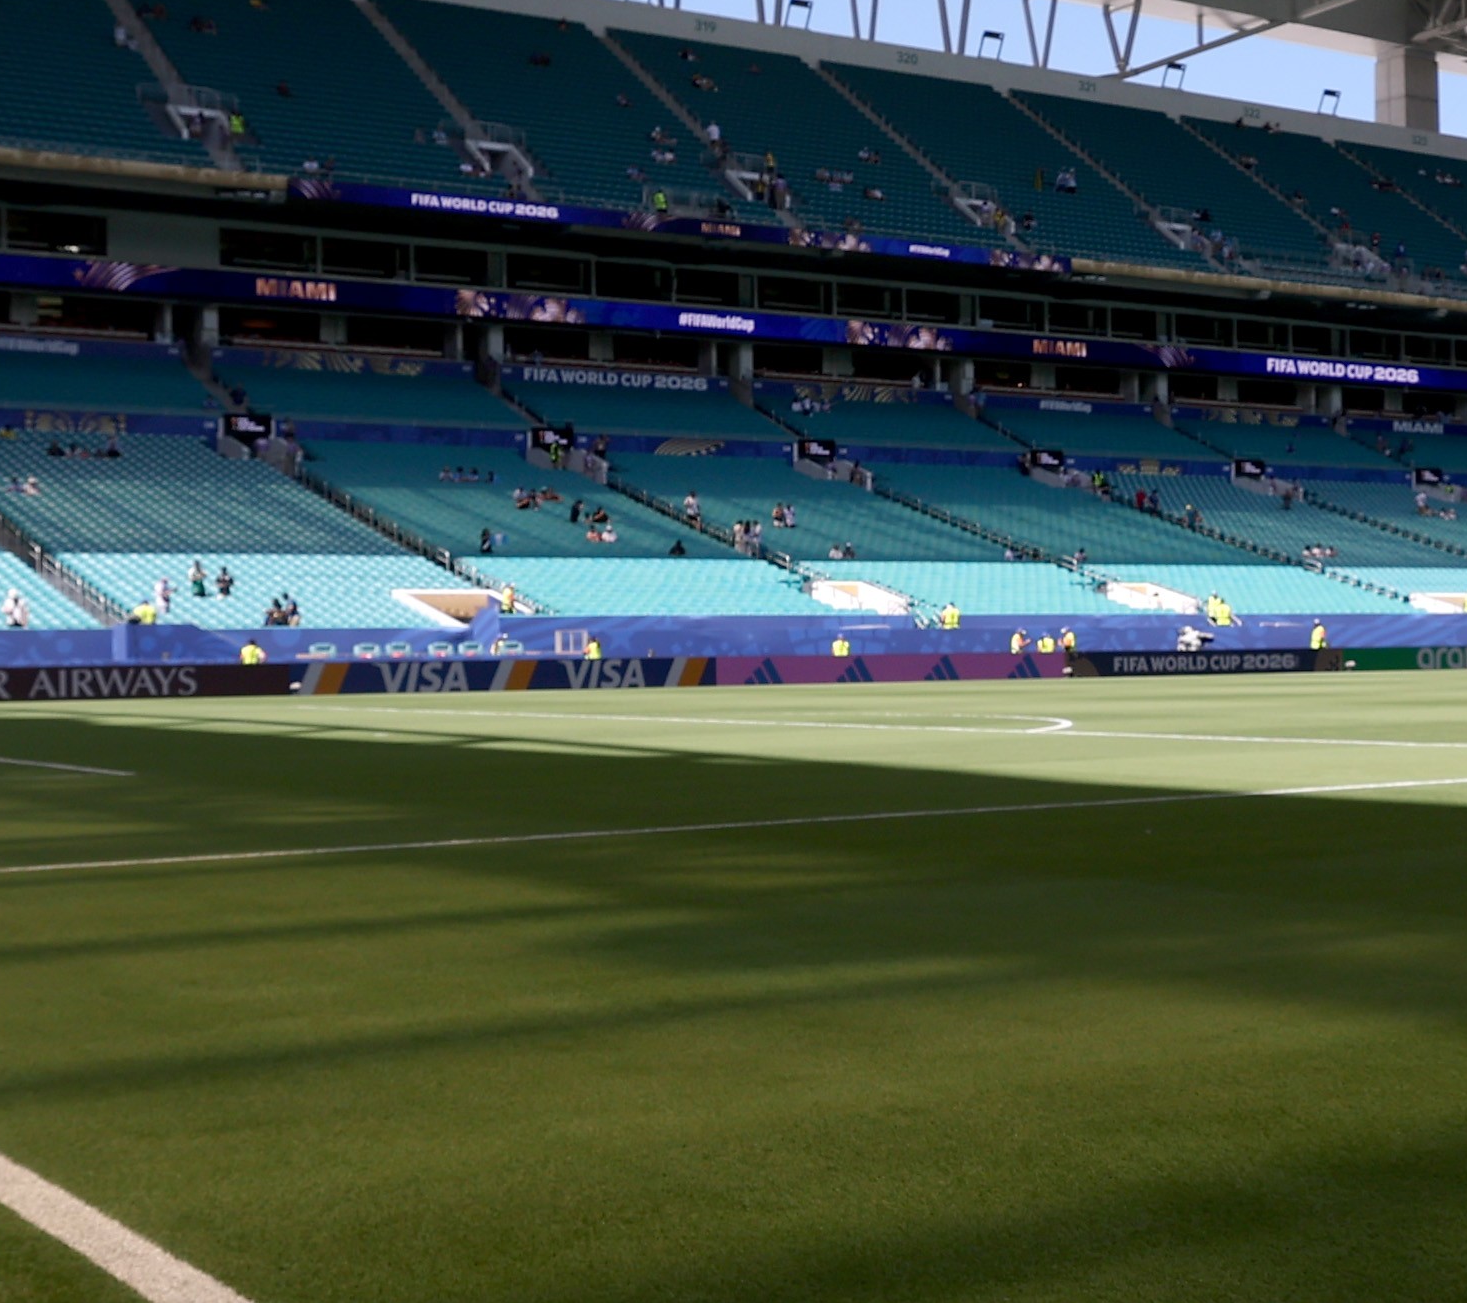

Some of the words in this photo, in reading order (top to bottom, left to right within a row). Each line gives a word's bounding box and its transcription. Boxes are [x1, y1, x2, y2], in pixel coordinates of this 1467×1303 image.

[411, 193, 440, 207] FIFA
[440, 196, 487, 211] WORLD
[488, 201, 514, 215] CUP
[514, 203, 559, 219] 2026
[255, 277, 337, 302] MIAMI
[678, 312, 755, 334] #FIFAWorldCup
[1033, 339, 1087, 358] MIAMI
[523, 367, 558, 383] FIFA
[560, 369, 619, 387] WORLD
[620, 373, 652, 388] CUP
[653, 375, 708, 391] 2026
[1267, 357, 1297, 374] FIFA
[1297, 360, 1346, 378] WORLD
[1346, 363, 1373, 380] CUP
[1373, 366, 1420, 384] 2026
[1393, 420, 1444, 434] MIAMI
[561, 659, 646, 690] VISA
[1113, 656, 1148, 672] FIFA
[1151, 655, 1207, 672] WORLD
[1208, 655, 1240, 671] CUP
[1242, 653, 1296, 670] 2026
[28, 667, 198, 698] AIRWAYS
[378, 660, 470, 693] VISA
